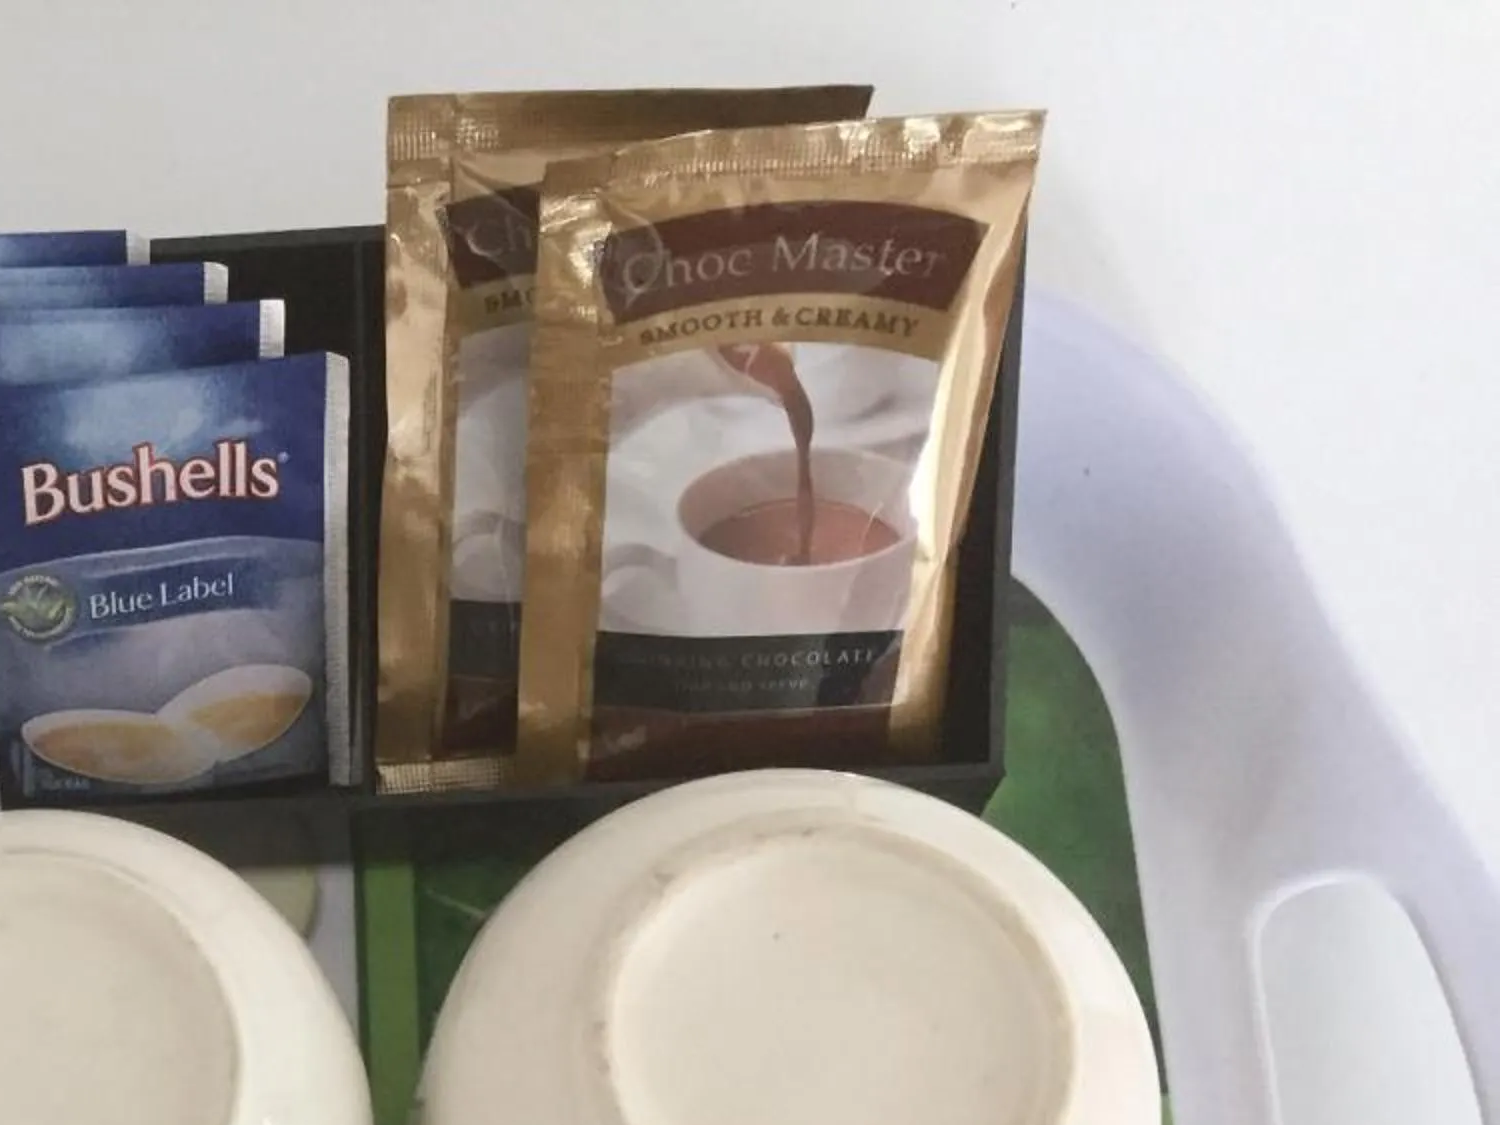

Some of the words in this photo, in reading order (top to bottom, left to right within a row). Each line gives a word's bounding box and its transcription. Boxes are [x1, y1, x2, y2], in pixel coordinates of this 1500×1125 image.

[622, 246, 753, 295] Choc
[771, 230, 947, 280] Master
[639, 308, 763, 347] SMOOTH
[794, 306, 920, 338] CREAMY
[20, 438, 281, 526] Bushells
[89, 591, 153, 620] Blue
[159, 572, 235, 606] Label
